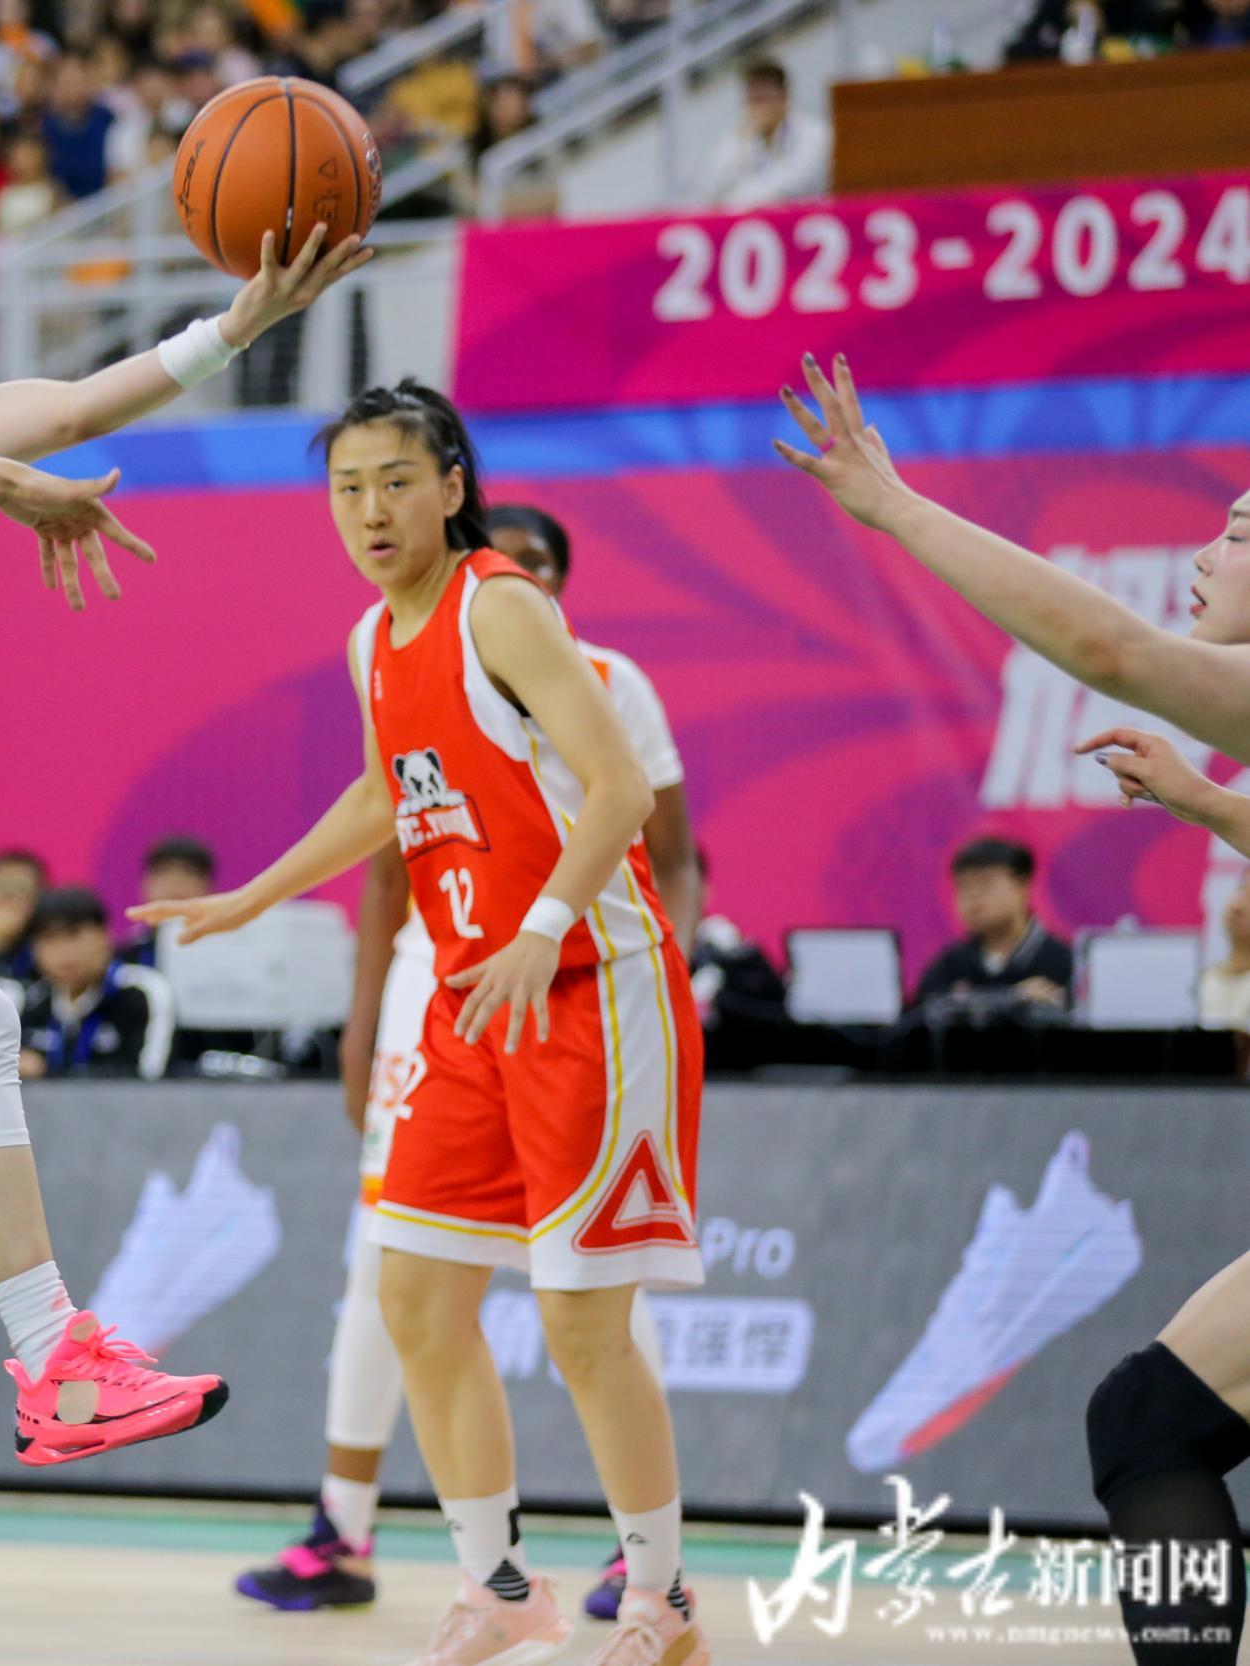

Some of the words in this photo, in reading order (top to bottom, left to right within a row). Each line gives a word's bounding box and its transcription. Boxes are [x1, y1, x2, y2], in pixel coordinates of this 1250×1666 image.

[653, 186, 1250, 323] 2023-2024
[438, 867, 485, 939] 12
[700, 1216, 797, 1281] Pro
